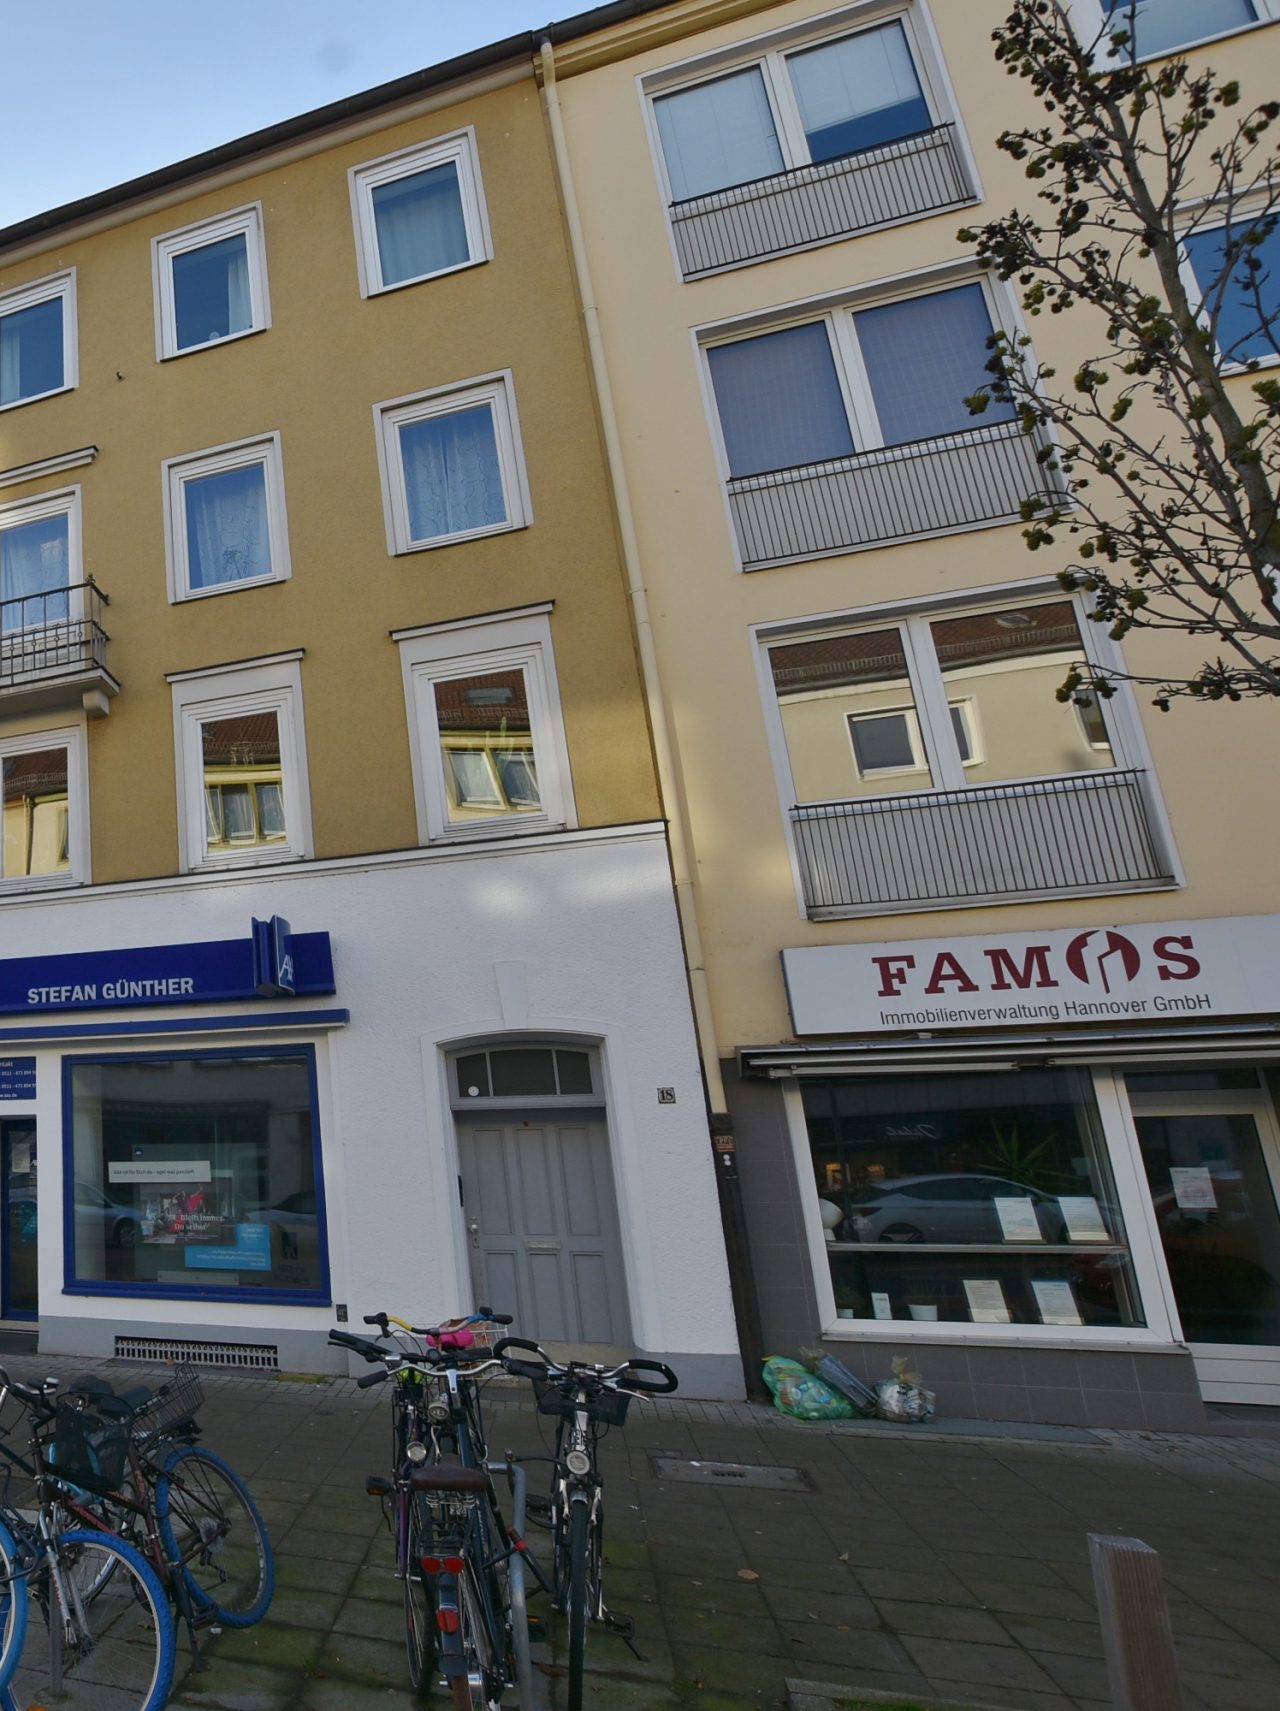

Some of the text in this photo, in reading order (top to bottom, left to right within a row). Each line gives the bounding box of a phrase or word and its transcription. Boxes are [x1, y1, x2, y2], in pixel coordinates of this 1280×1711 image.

[871, 930, 1201, 997] FAMOS
[27, 977, 194, 1003] STEFAN GÜNTHER
[880, 994, 1212, 1025] Immobilienverwaltung Hannover GmbH
[660, 1089, 674, 1101] 18
